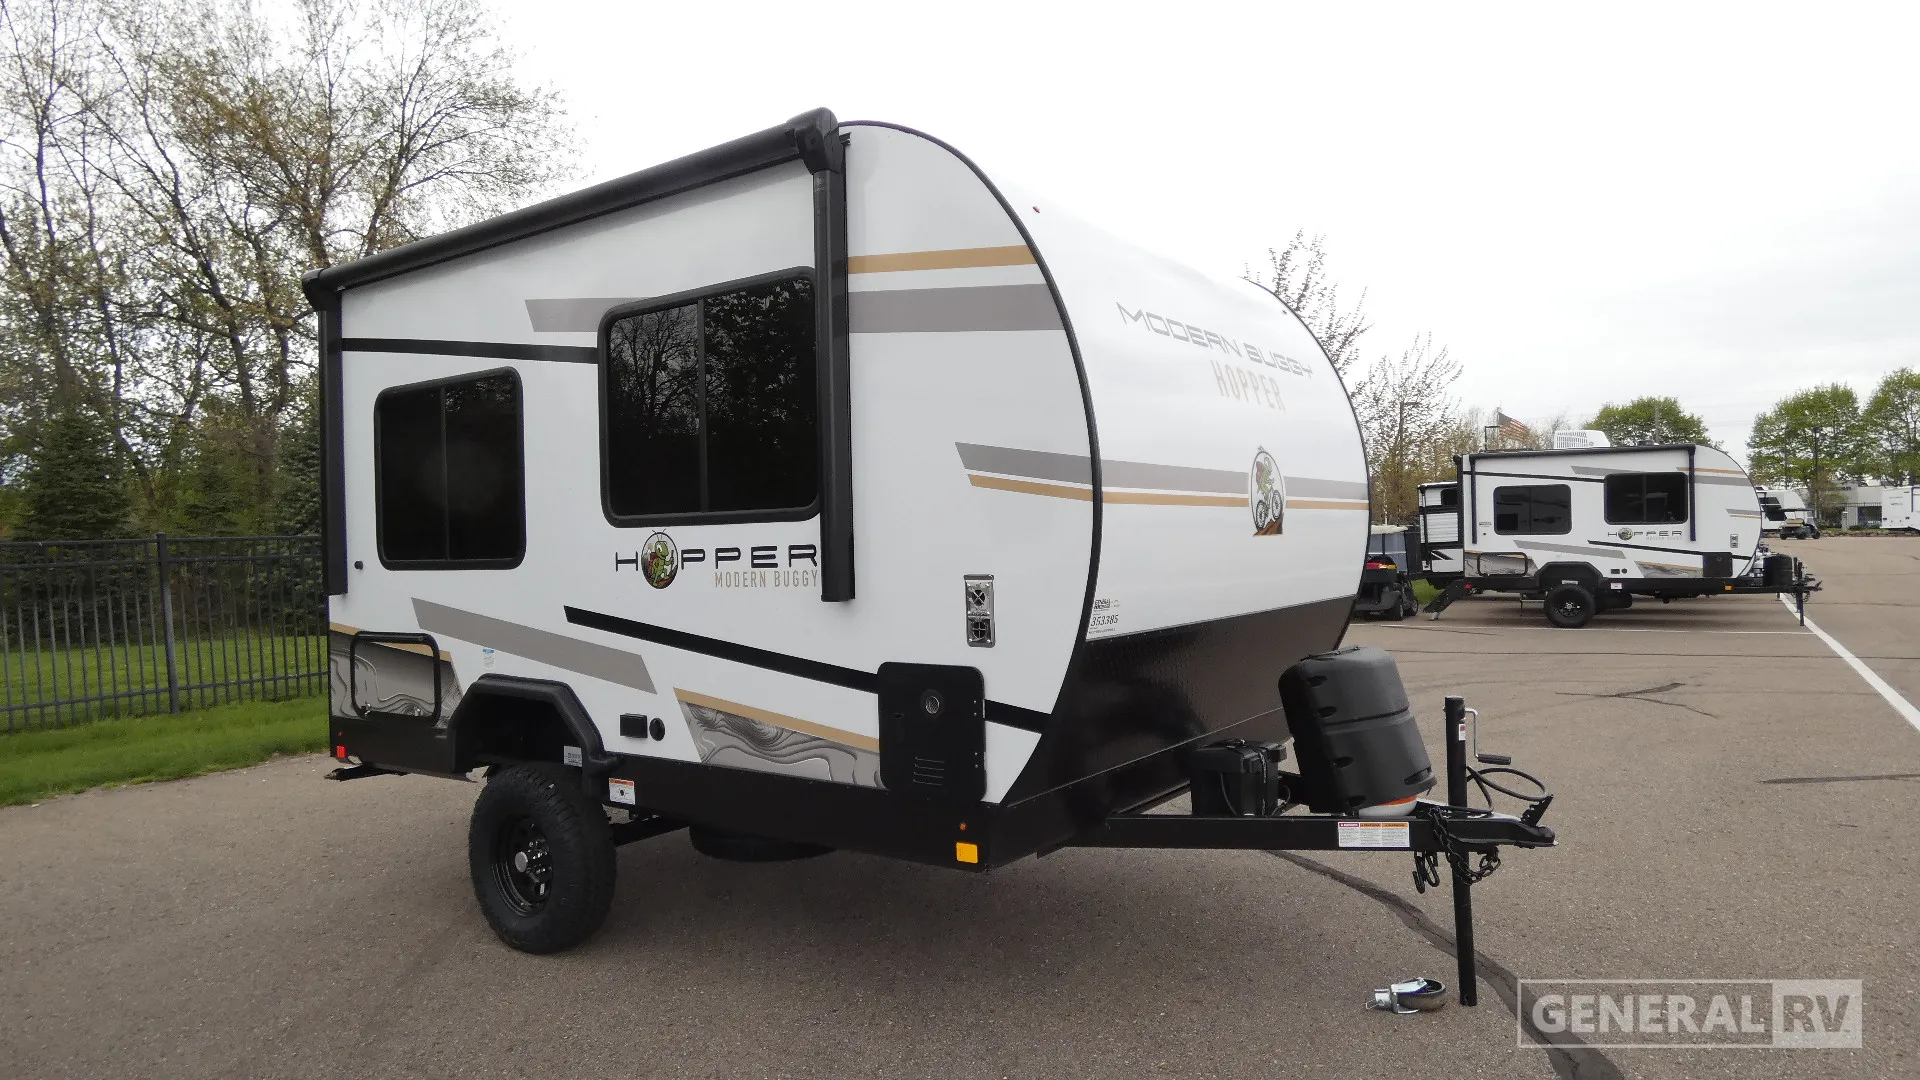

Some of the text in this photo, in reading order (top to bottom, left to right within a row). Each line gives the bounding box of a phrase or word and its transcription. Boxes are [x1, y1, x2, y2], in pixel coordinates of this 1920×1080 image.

[1116, 302, 1313, 378] MODERN BUGGY
[1210, 360, 1286, 411] HOPPER
[615, 532, 818, 589] HOPPER
[714, 570, 818, 588] MODERN BUGGY
